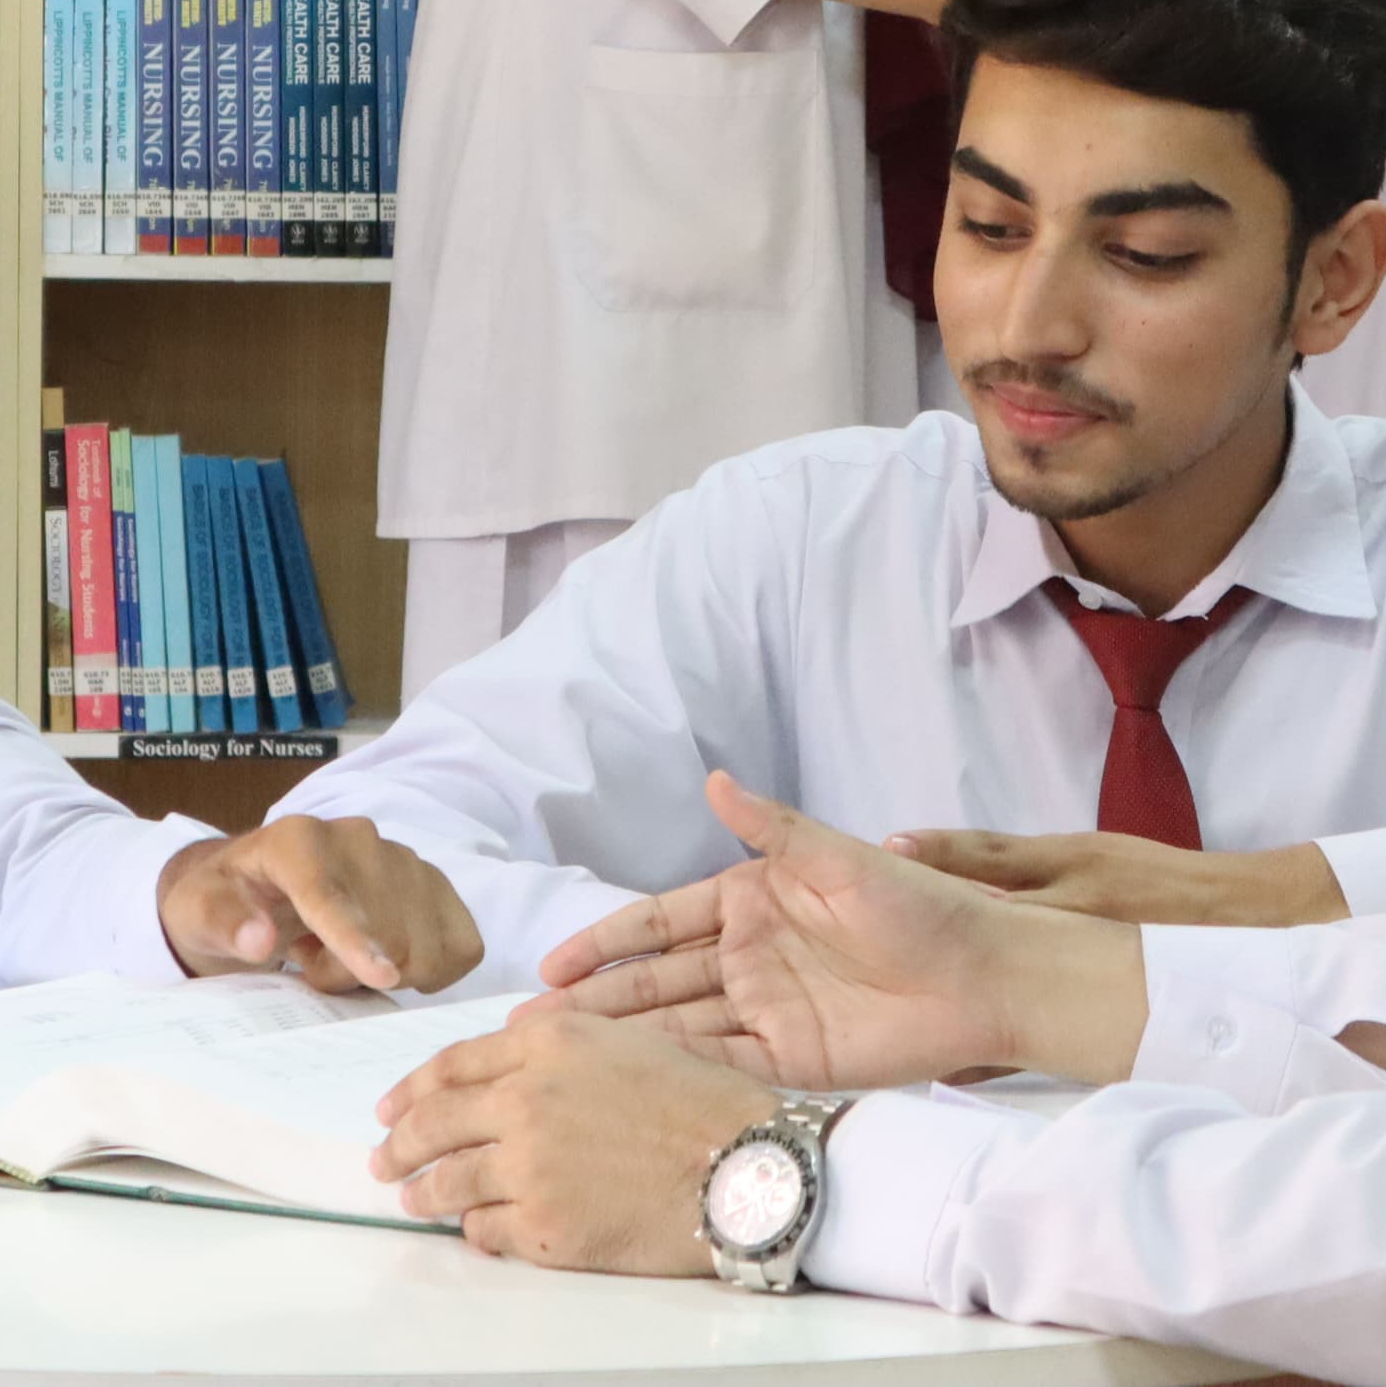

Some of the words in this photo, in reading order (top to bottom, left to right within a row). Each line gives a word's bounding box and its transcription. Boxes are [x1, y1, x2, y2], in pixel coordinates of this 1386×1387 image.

[52, 10, 62, 89] LIPPINCOTTS
[294, 43, 308, 84] CARE
[325, 43, 339, 84] CARE
[357, 43, 371, 84] CARE
[52, 92, 62, 143] MANUAL
[143, 42, 164, 166] NURSING
[180, 45, 201, 169] NURSING
[217, 43, 238, 167] NURSING
[253, 45, 274, 168] NURSING
[52, 145, 62, 163] OF
[47, 449, 60, 487] Lohumi
[76, 438, 92, 500] Sociology
[79, 505, 93, 523] for
[49, 517, 64, 592] SOCIOLOGY
[78, 529, 95, 580] Nursing
[82, 583, 96, 638] Students
[132, 739, 221, 762] Sociology
[227, 739, 254, 755] for
[260, 740, 323, 756] Nurses
